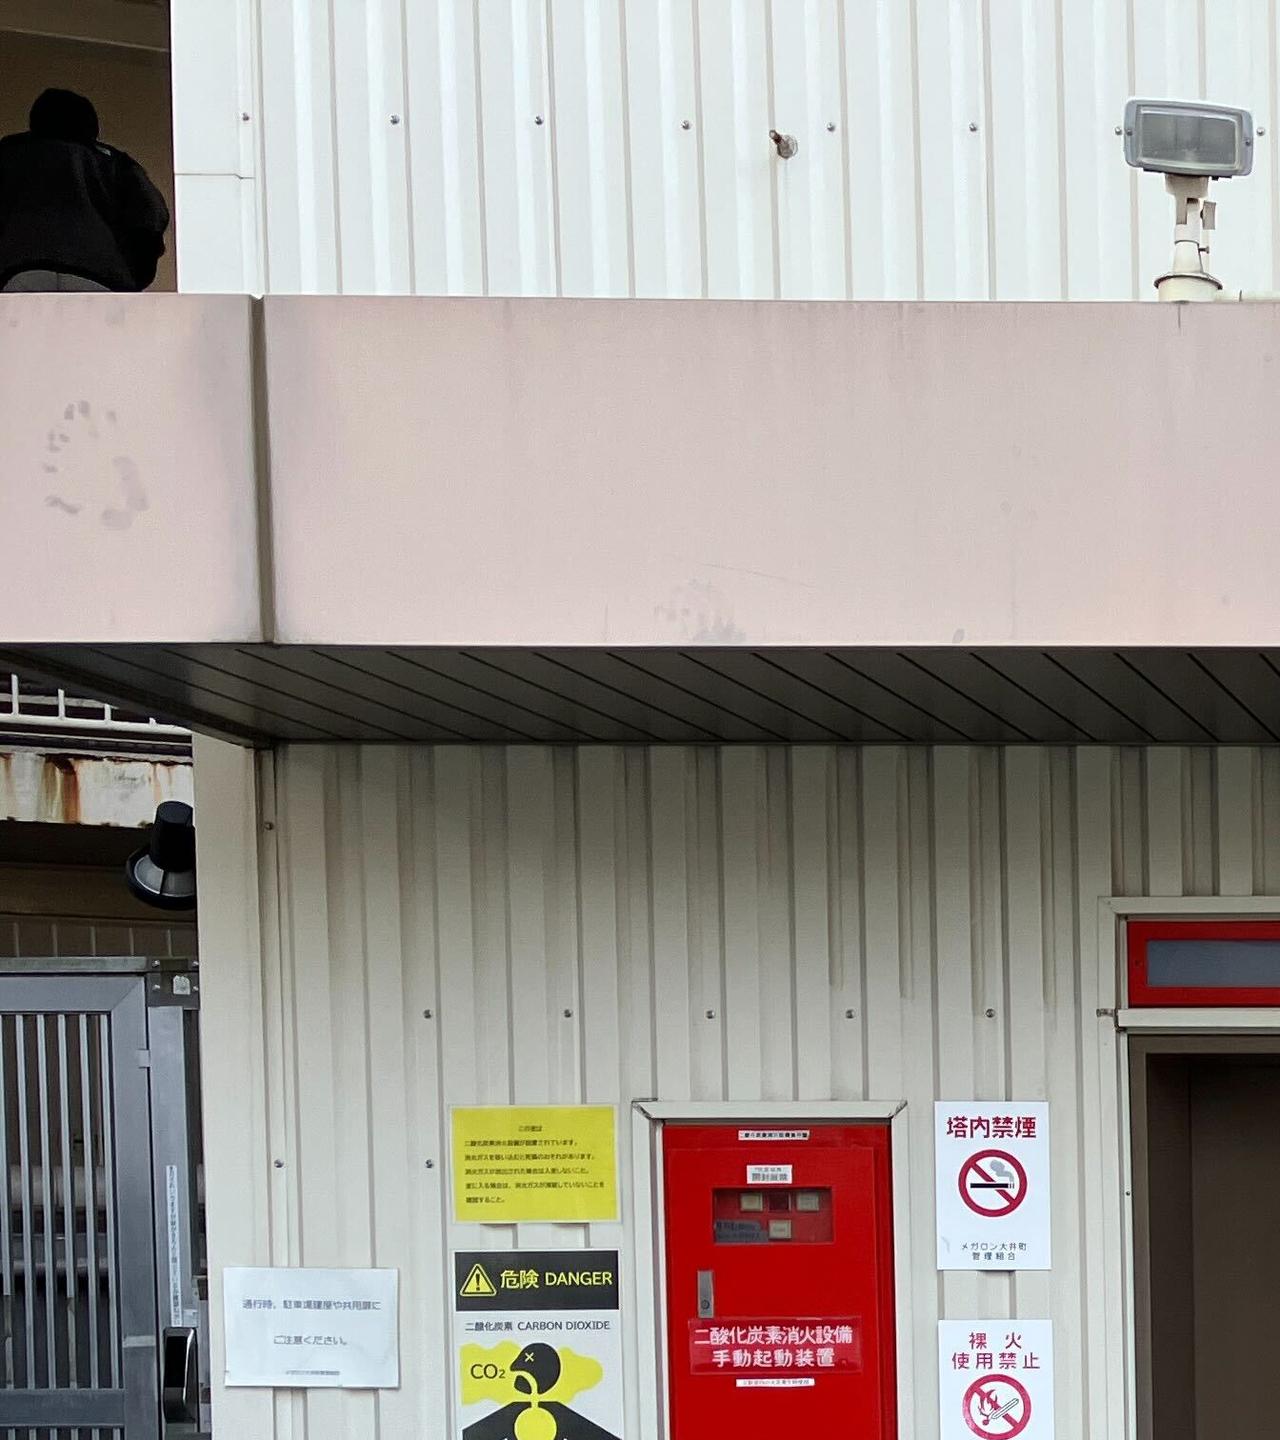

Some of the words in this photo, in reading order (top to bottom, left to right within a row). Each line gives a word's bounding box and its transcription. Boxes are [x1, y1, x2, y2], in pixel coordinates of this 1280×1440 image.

[946, 1115, 1037, 1139] 塔内禁煙
[500, 1270, 539, 1289] 危険
[545, 1271, 612, 1286] DANGER
[465, 1321, 513, 1331] 二酸化炭素
[518, 1321, 563, 1331] CARBON
[566, 1321, 611, 1330] DIOXIDE
[694, 1325, 853, 1345] 二酸化炭素消火設備
[712, 1348, 835, 1368] 手動起動装置
[951, 1352, 1041, 1370] 使用禁止
